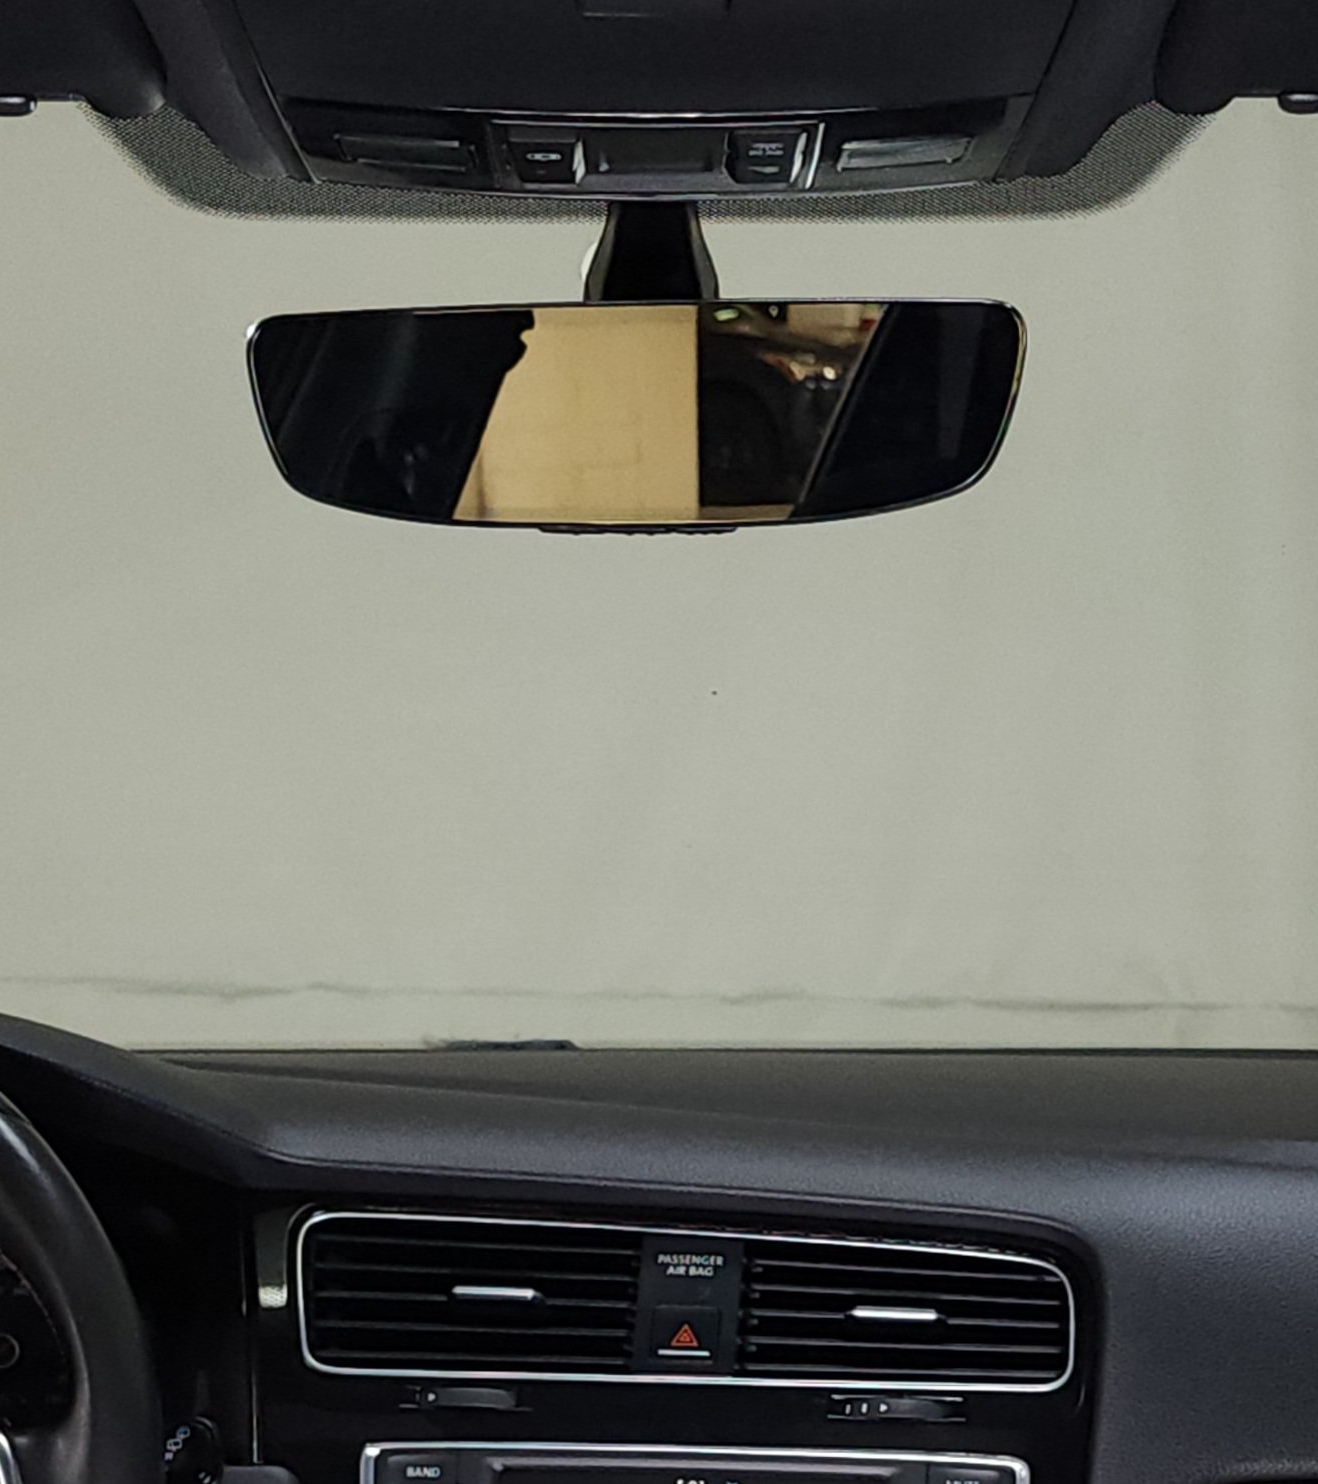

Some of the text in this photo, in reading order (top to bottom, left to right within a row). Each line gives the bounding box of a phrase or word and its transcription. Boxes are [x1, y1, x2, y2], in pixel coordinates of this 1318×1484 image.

[657, 1254, 724, 1266] PASSENGER
[666, 1266, 714, 1276] AIR BAG
[406, 1465, 442, 1479] BAND
